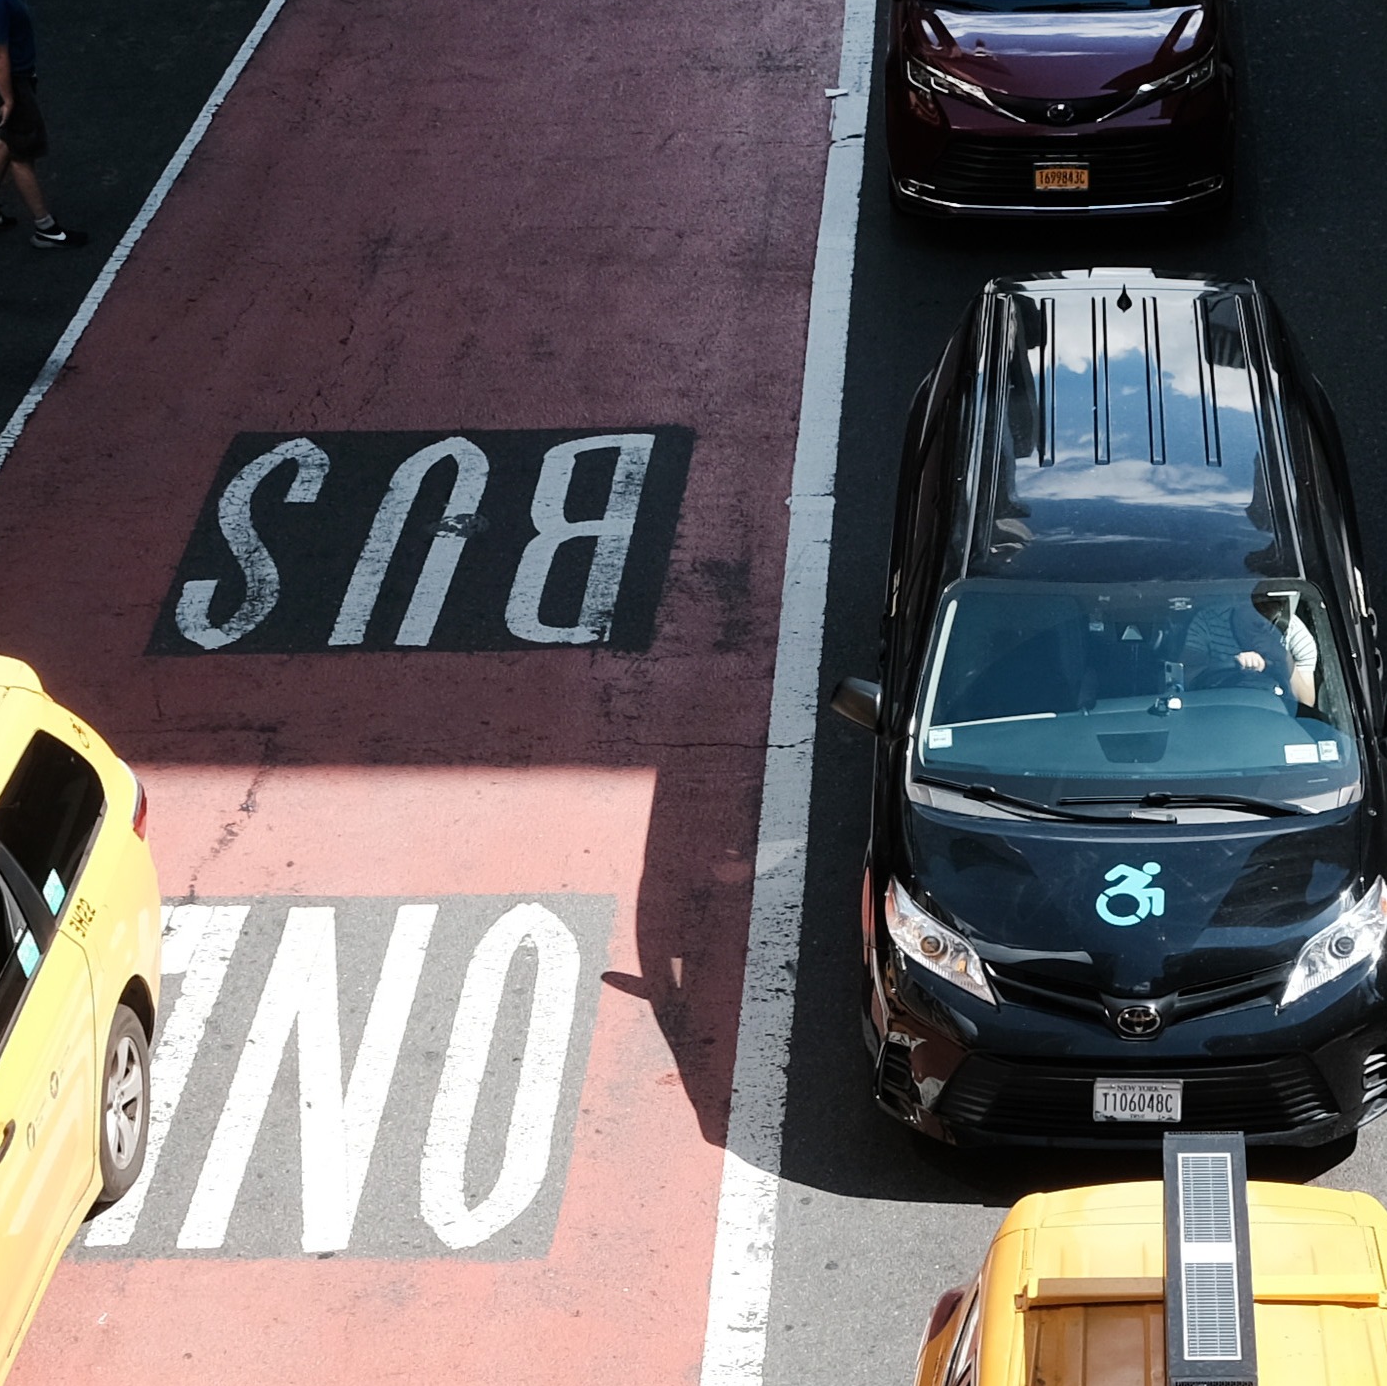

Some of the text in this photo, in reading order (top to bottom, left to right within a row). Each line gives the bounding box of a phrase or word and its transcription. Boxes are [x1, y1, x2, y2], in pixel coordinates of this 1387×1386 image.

[174, 434, 655, 650] BUS
[1117, 1084, 1135, 1092] NEW
[1102, 1093, 1174, 1113] T106048C
